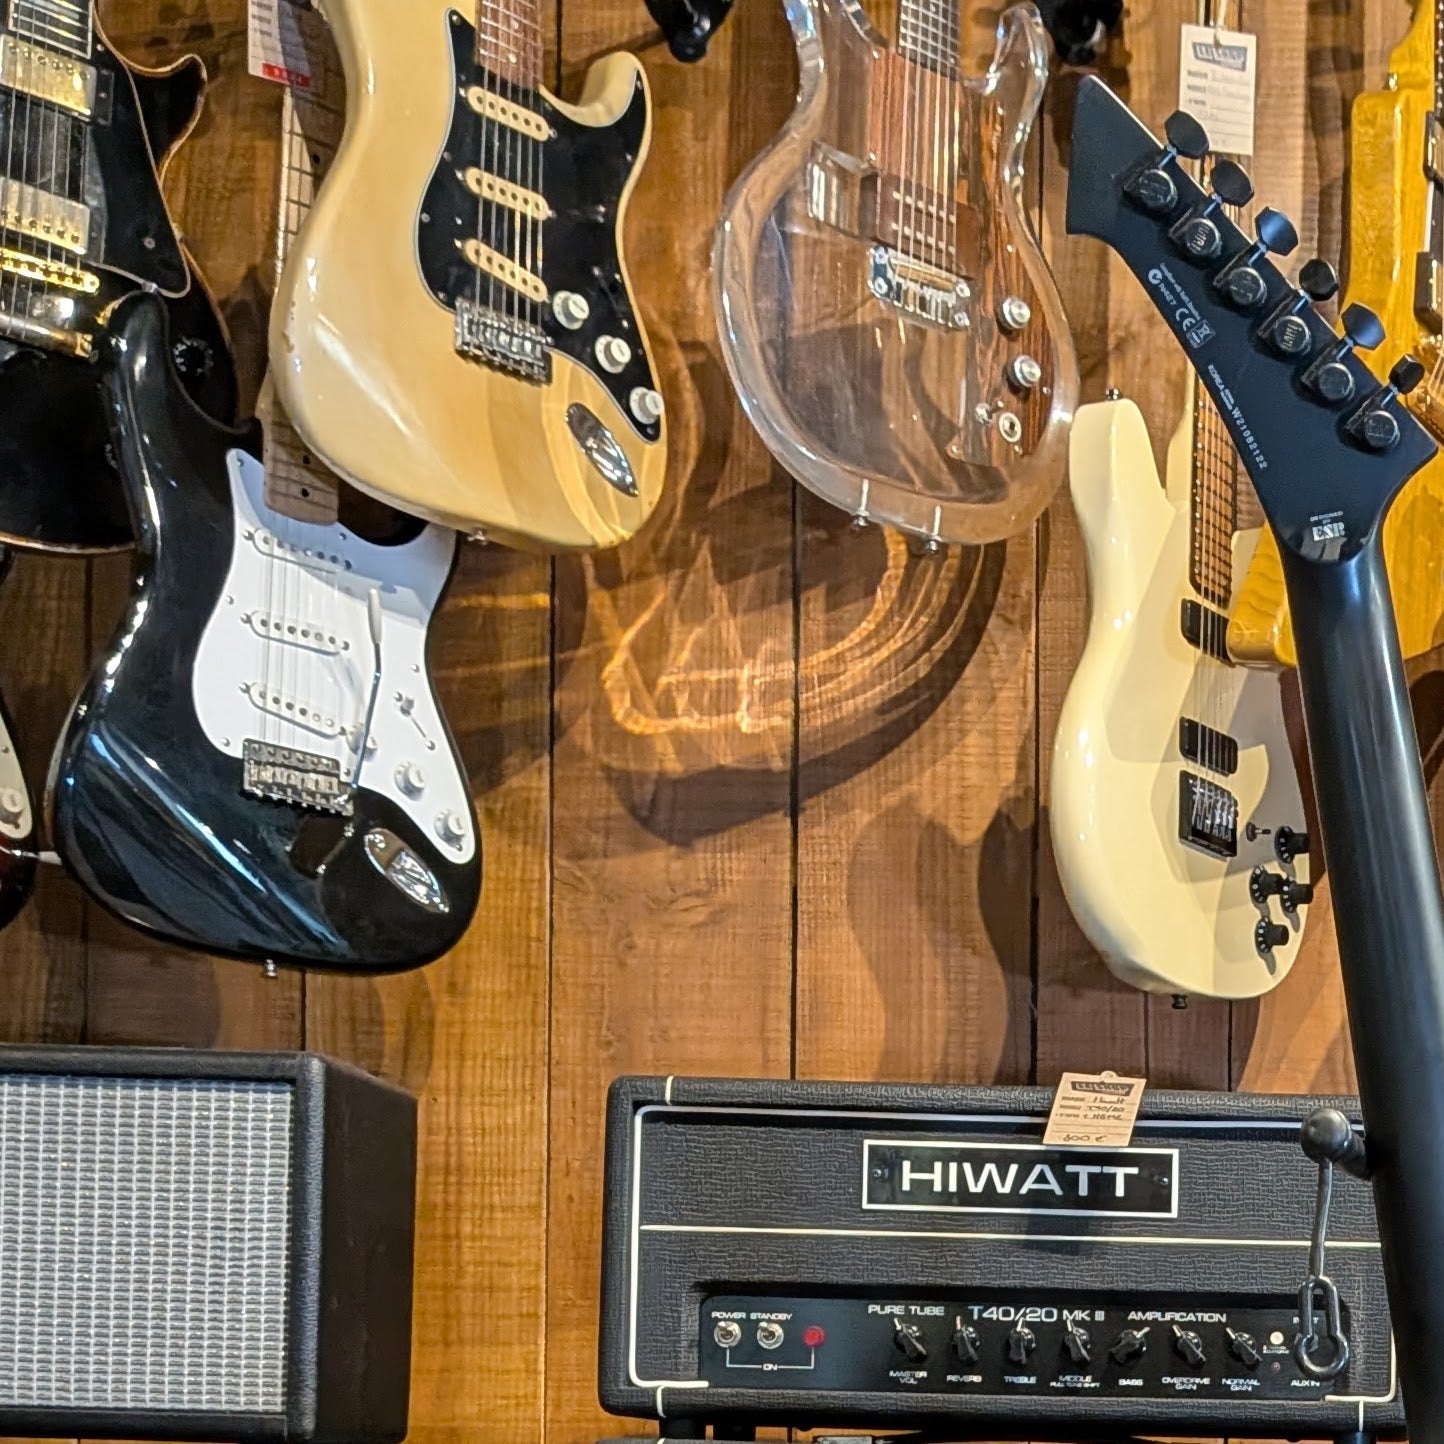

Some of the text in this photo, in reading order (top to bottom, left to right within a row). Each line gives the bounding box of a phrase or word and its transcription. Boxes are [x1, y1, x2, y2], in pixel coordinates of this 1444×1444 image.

[901, 1160, 1139, 1197] HIWATT
[711, 1311, 747, 1320] POWER
[749, 1312, 793, 1320] STANDBY
[868, 1304, 905, 1315] PURE
[908, 1306, 945, 1316] TUBE
[968, 1305, 1058, 1322] T40/20
[1062, 1309, 1091, 1321] MK
[1127, 1311, 1227, 1322] AMPLIFICATION
[763, 1363, 779, 1371] ON
[889, 1370, 928, 1378] MASTER
[1003, 1376, 1037, 1384] TREBLE
[1118, 1378, 1143, 1386] BASS
[1221, 1378, 1260, 1386] NORMAL
[1230, 1384, 1252, 1392] GAIN
